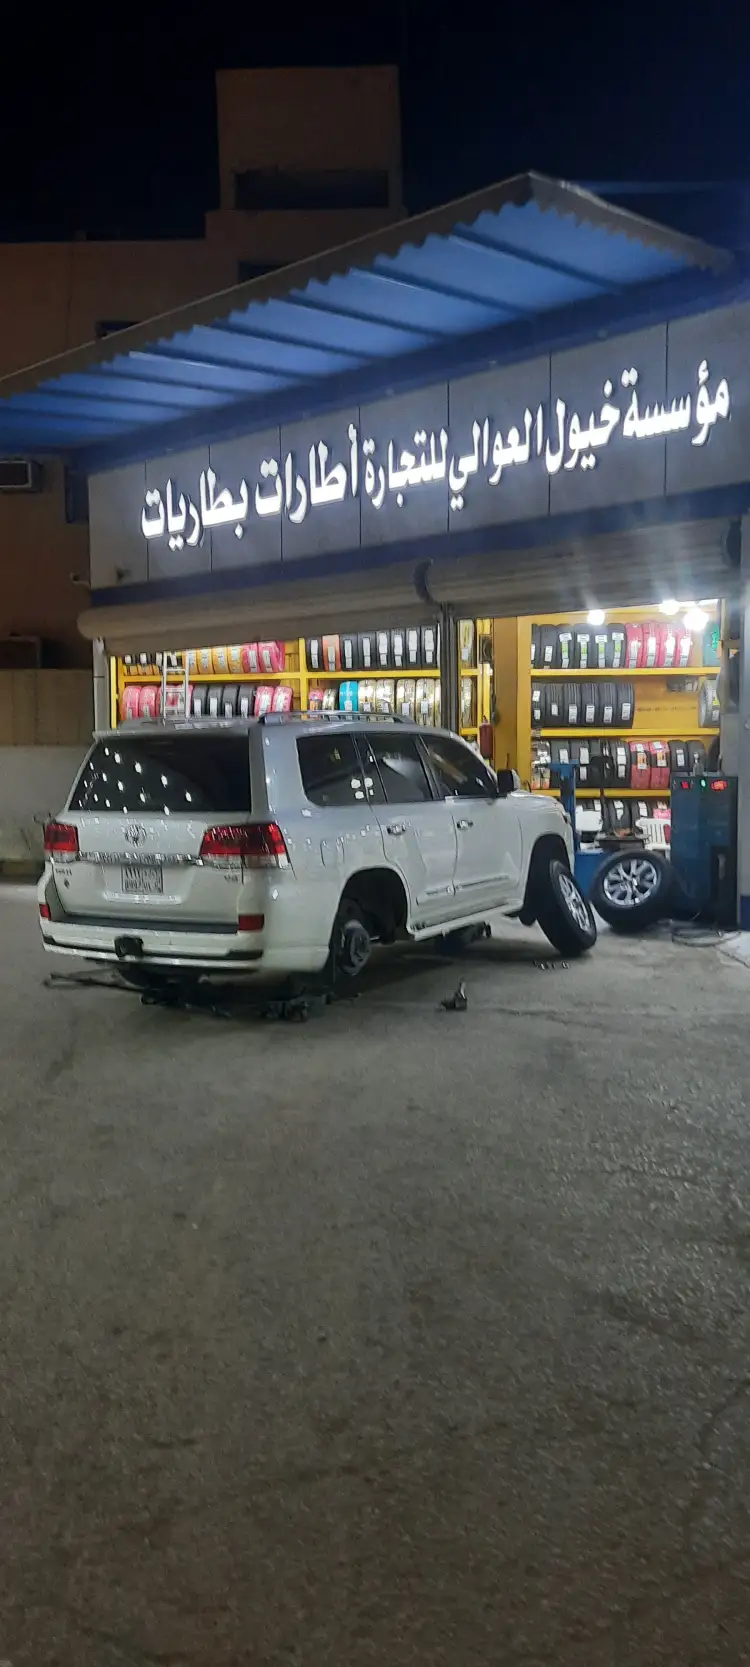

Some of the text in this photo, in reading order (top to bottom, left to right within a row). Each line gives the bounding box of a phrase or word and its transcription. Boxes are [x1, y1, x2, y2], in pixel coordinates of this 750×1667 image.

[546, 379, 620, 473] خيول
[622, 360, 730, 445] مؤسسة
[364, 428, 448, 509] للتجارة
[450, 404, 543, 510] العوالي
[142, 466, 248, 551] بطاريات
